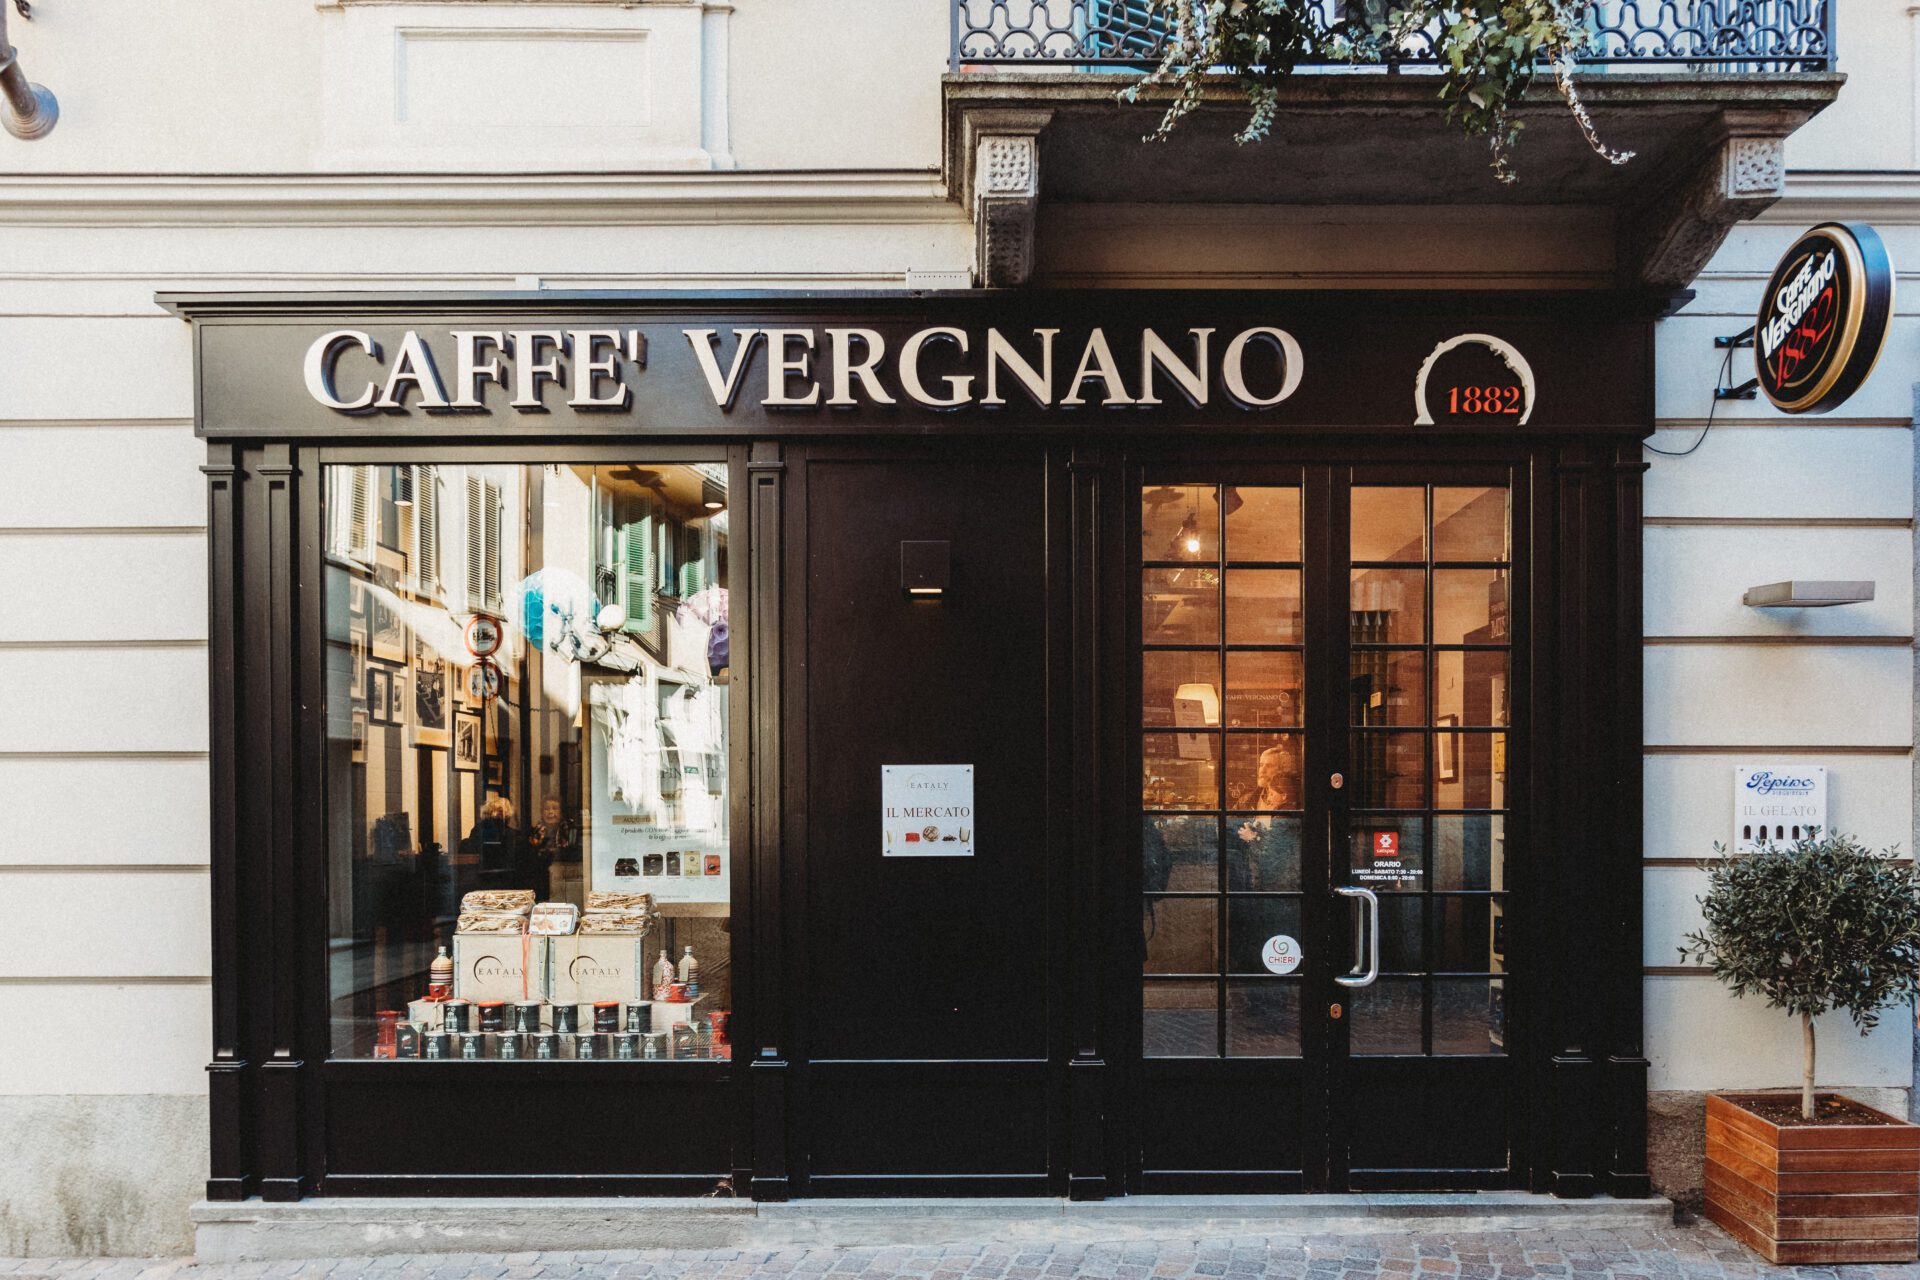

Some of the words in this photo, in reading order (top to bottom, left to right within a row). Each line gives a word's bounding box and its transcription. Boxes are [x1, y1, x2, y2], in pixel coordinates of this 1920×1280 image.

[1775, 287, 1833, 393] 1882
[682, 326, 1305, 409] VERGNANO
[1448, 386, 1521, 415] 1882
[1746, 771, 1816, 795] Pepino
[887, 807, 899, 818] IL
[903, 806, 970, 818] MERCATO
[1744, 805, 1757, 816] IL
[1761, 805, 1817, 816] GELATO
[1268, 956, 1296, 964] CHIERI
